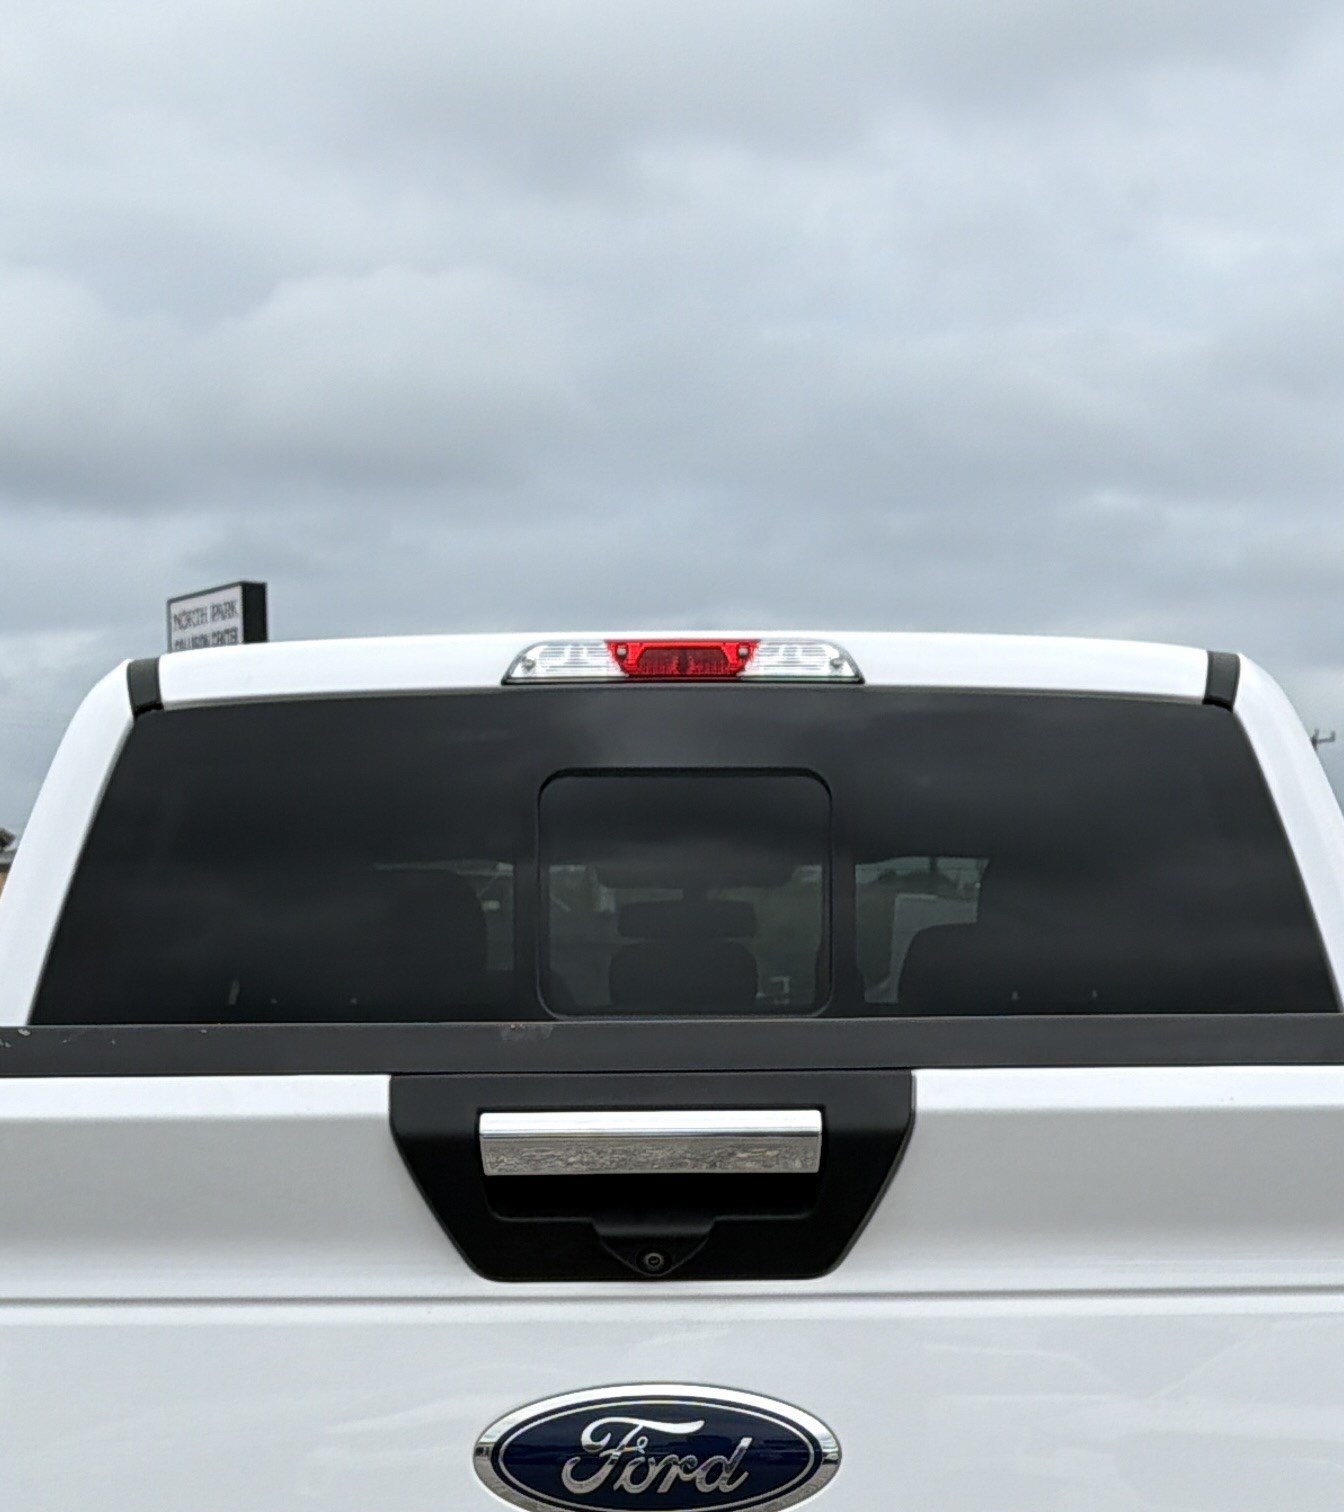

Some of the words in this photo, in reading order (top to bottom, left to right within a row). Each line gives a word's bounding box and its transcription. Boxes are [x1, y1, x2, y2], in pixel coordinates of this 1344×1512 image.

[173, 607, 208, 630] NORTH
[210, 600, 238, 621] PARK
[561, 1416, 752, 1494] Ford
